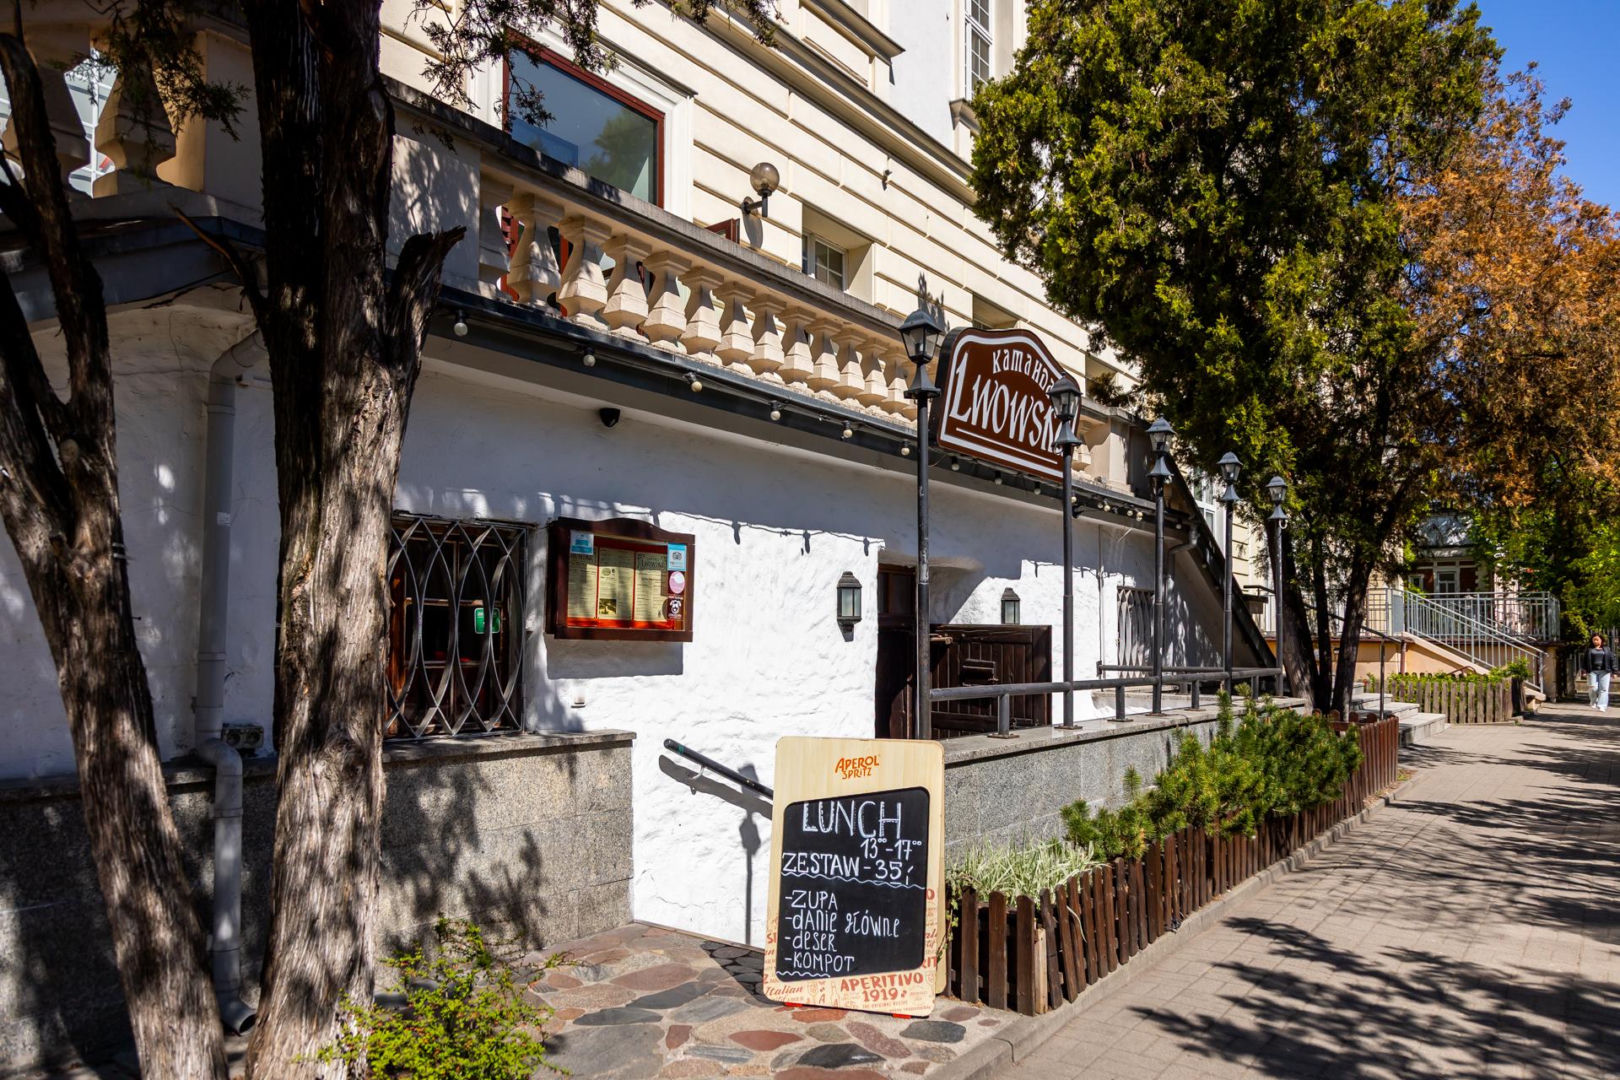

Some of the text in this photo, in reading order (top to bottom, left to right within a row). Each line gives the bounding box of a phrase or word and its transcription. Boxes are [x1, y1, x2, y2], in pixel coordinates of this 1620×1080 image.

[835, 755, 880, 773] APEROL
[841, 767, 872, 780] SPRITZ
[803, 800, 902, 839] LUNCH
[782, 852, 860, 877] ZESTAW
[766, 983, 804, 996] Italian
[840, 972, 924, 992] APERITIVO
[863, 987, 899, 1002] 1919
